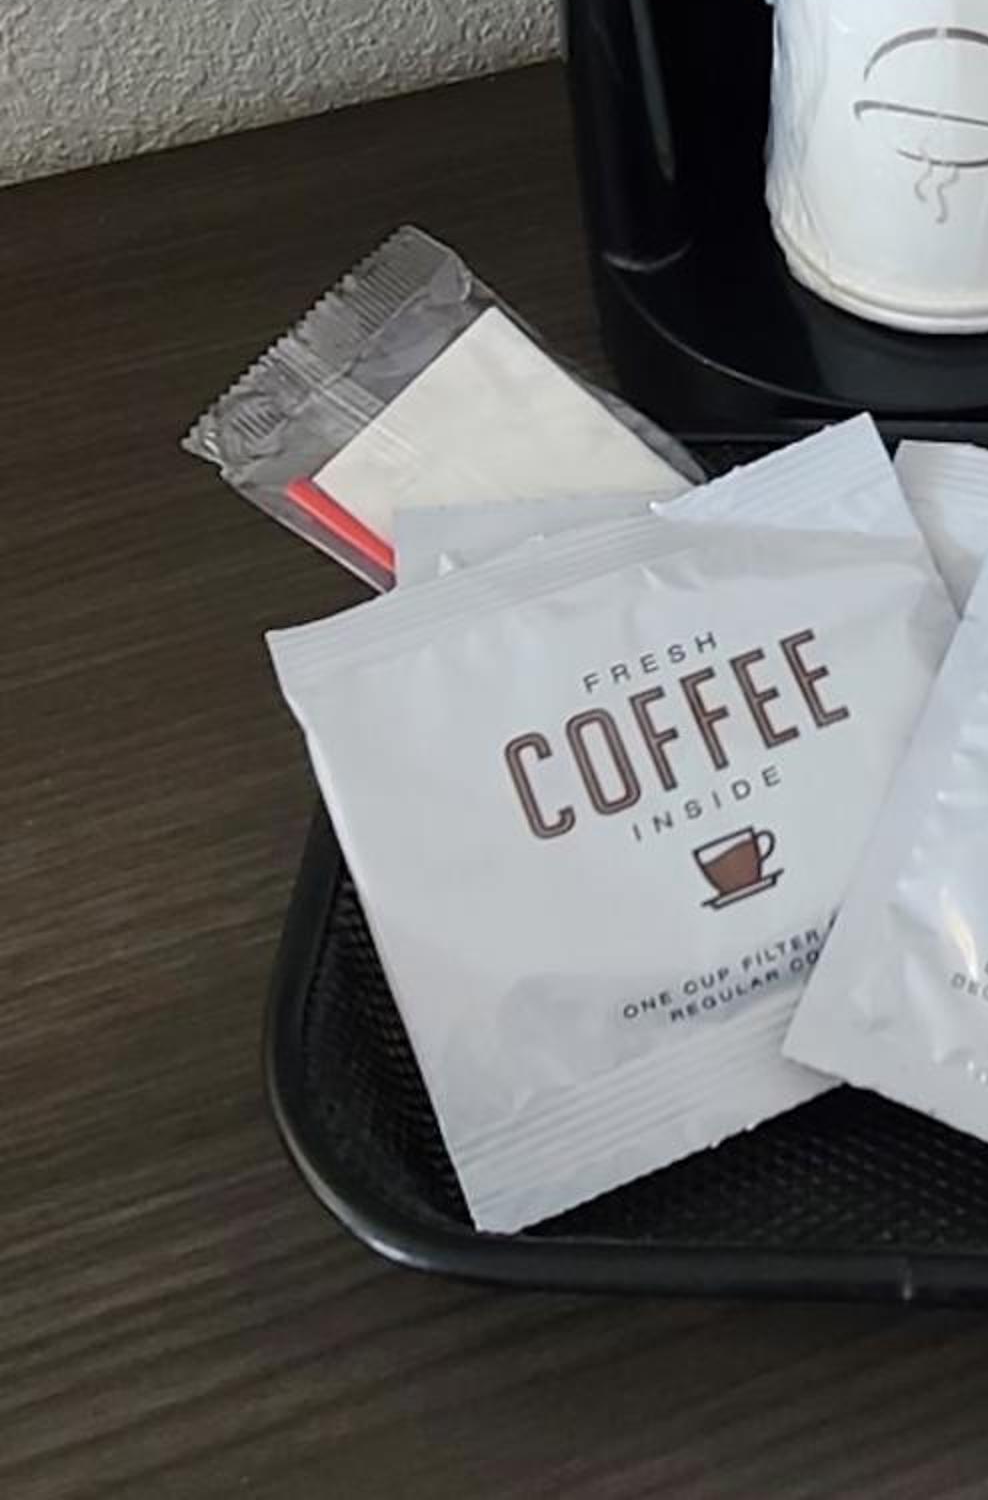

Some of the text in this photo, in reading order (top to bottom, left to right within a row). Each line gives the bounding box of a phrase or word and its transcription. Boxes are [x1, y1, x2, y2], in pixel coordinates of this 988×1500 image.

[583, 631, 718, 693] FRESH
[504, 629, 851, 840] COFFEE
[632, 765, 783, 841] INSIDE
[622, 991, 673, 1019] ONE
[683, 968, 730, 995] CUP
[741, 928, 820, 972] FILTER
[669, 969, 780, 1023] REGULAR
